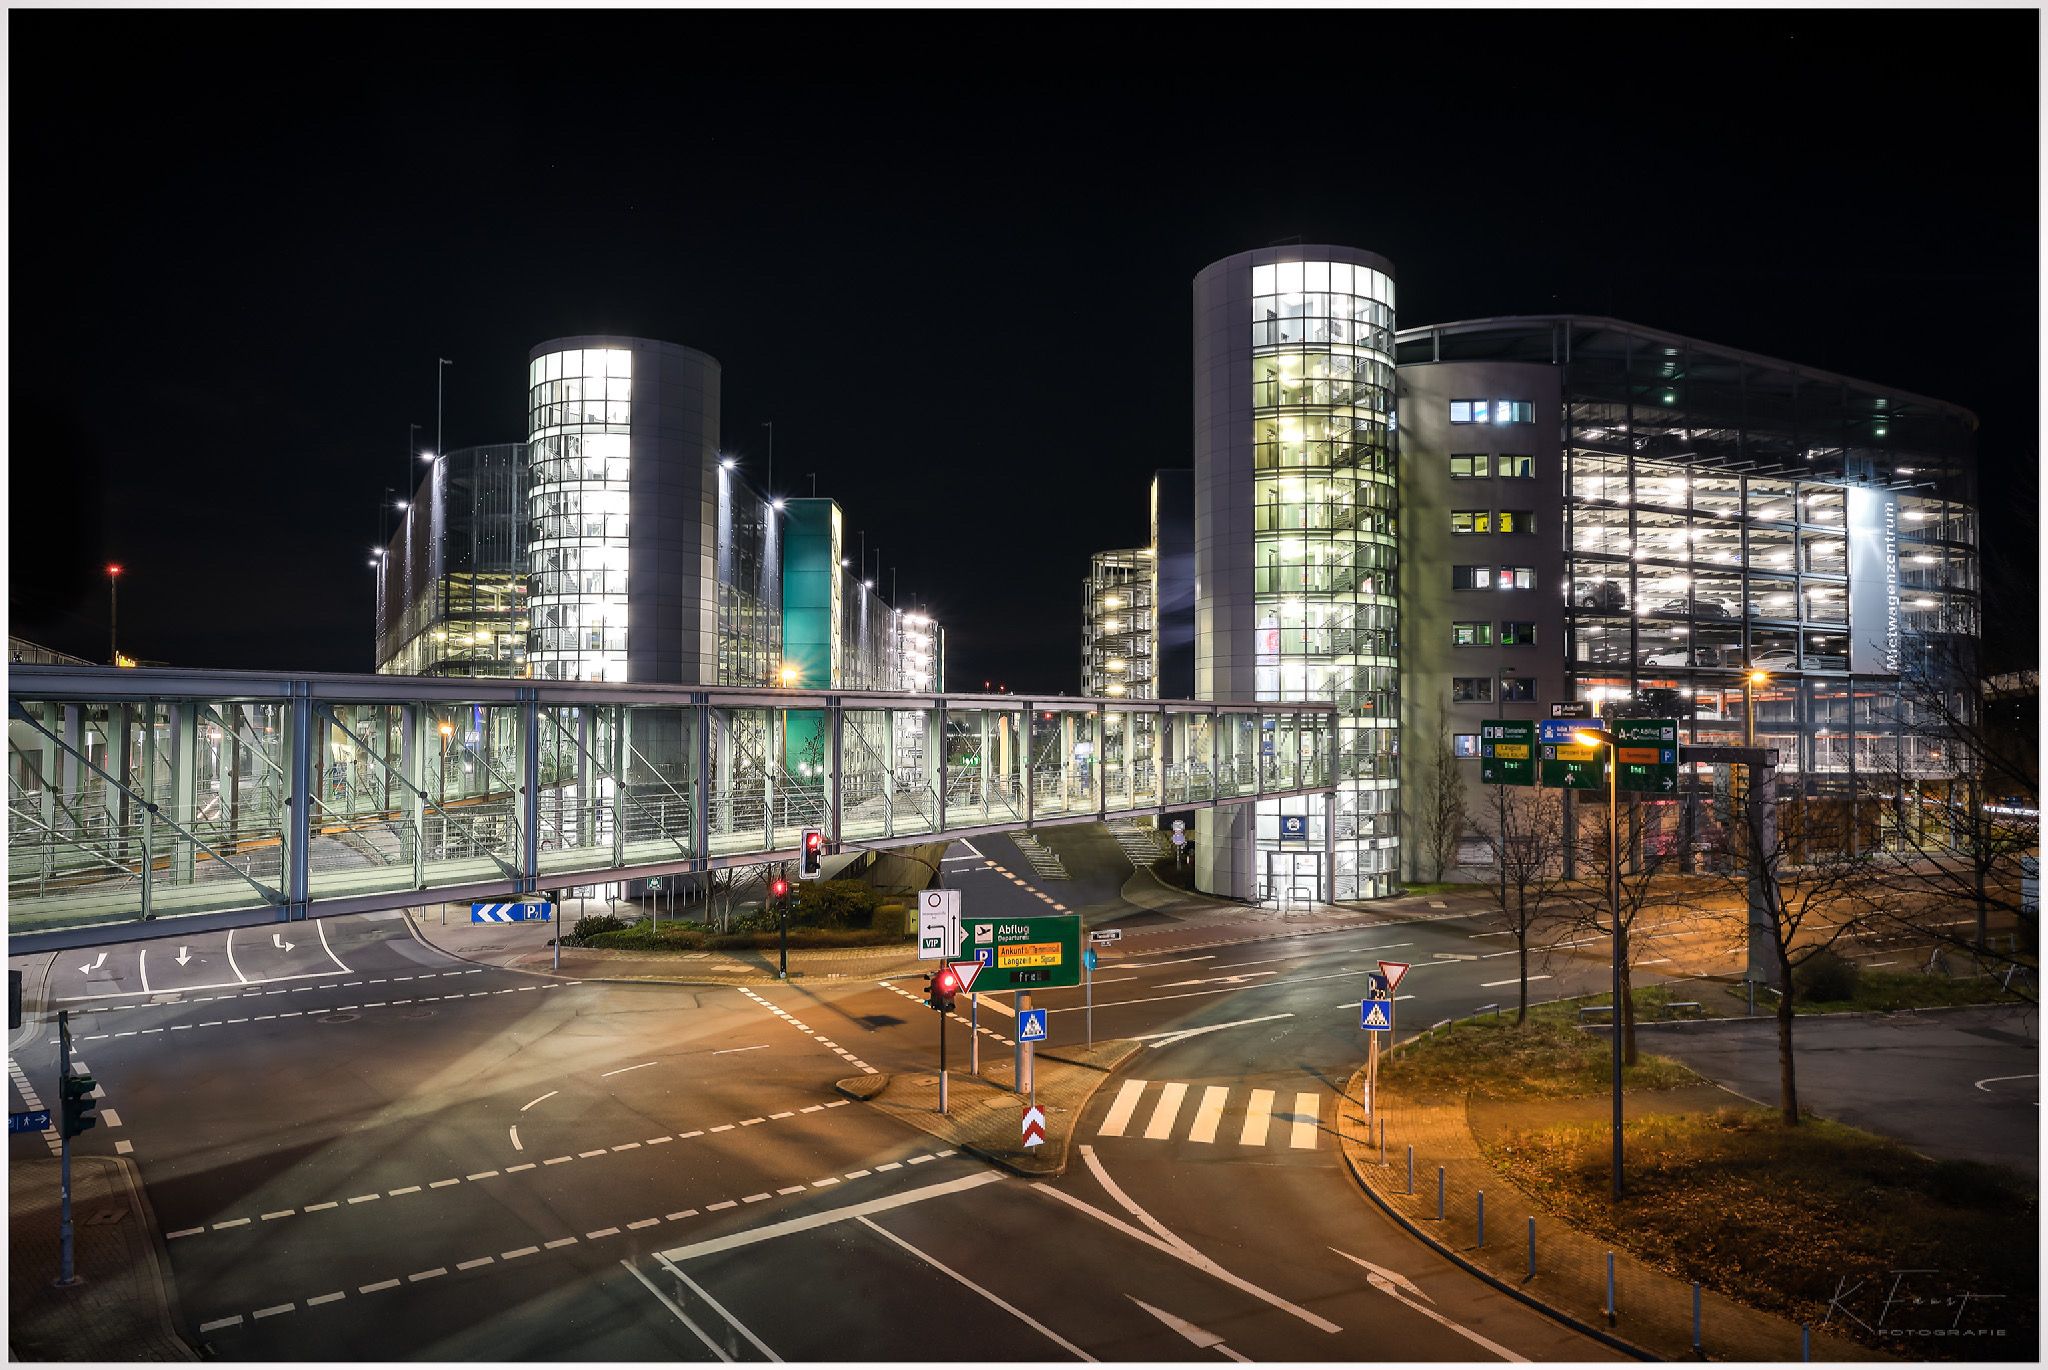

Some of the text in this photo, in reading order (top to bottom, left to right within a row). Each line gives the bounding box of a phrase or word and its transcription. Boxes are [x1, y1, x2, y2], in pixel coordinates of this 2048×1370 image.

[1885, 502, 1899, 670] Mietwagenzentrum
[998, 924, 1030, 936] Abflug
[926, 939, 939, 948] VIP
